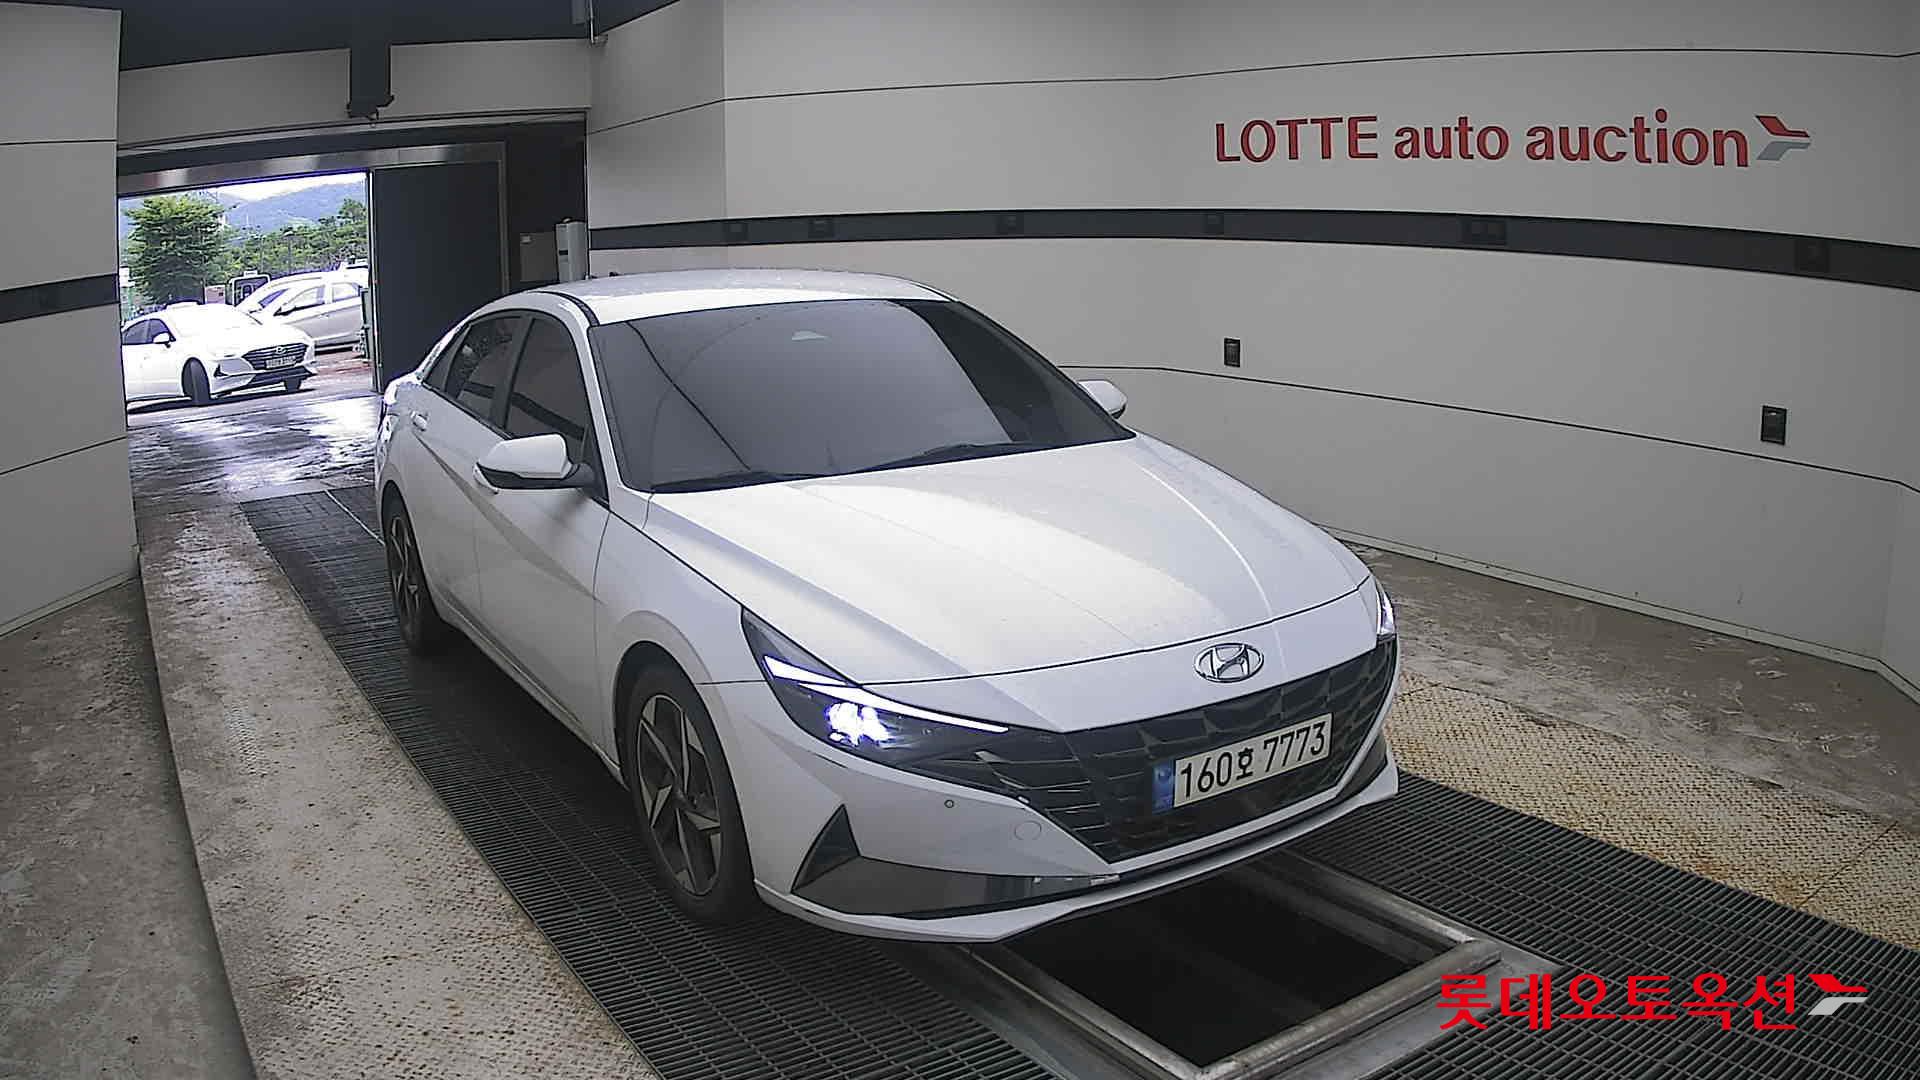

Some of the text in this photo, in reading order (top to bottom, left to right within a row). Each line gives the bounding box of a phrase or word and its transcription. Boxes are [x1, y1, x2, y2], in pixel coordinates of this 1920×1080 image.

[1215, 108, 1749, 167] LOTTE auto auction
[1180, 721, 1326, 798] 160호 7773
